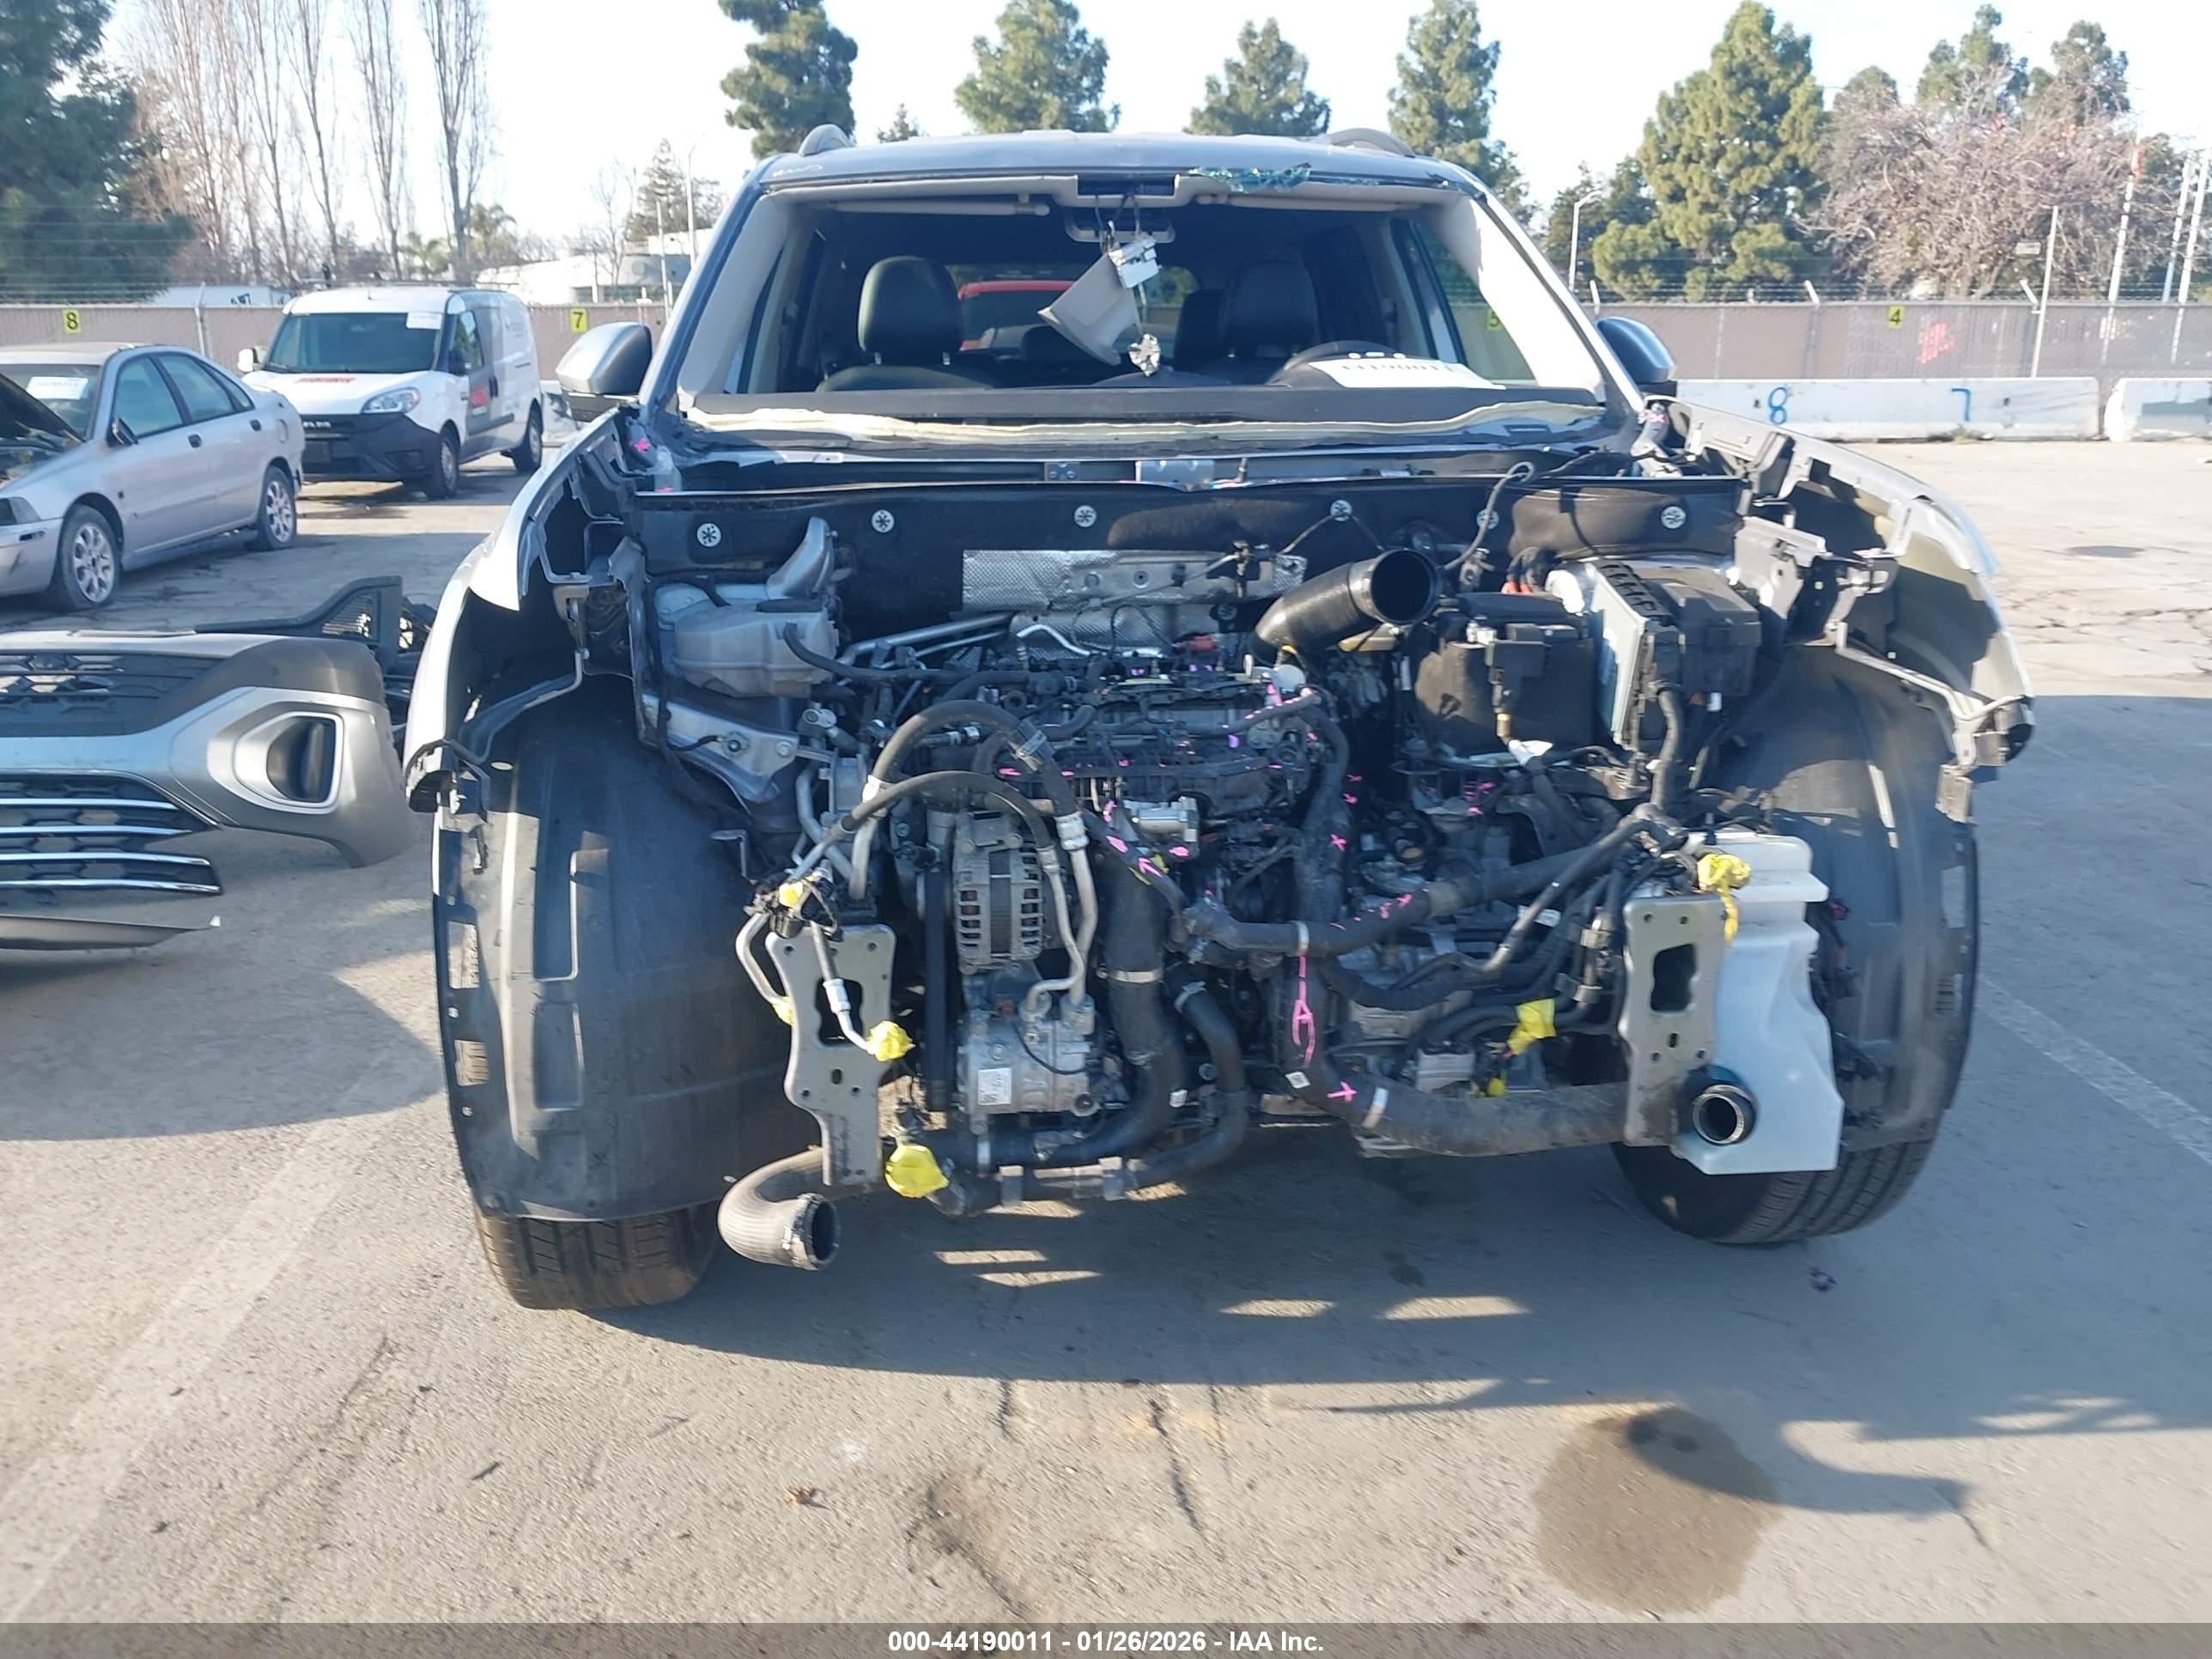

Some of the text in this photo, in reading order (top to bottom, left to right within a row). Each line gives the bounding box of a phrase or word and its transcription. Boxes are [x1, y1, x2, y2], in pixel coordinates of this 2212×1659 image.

[67, 312, 78, 330] 8
[573, 311, 583, 329] 7
[1889, 308, 1901, 325] 4
[1768, 386, 1788, 425] 8
[1951, 387, 1972, 422] 7
